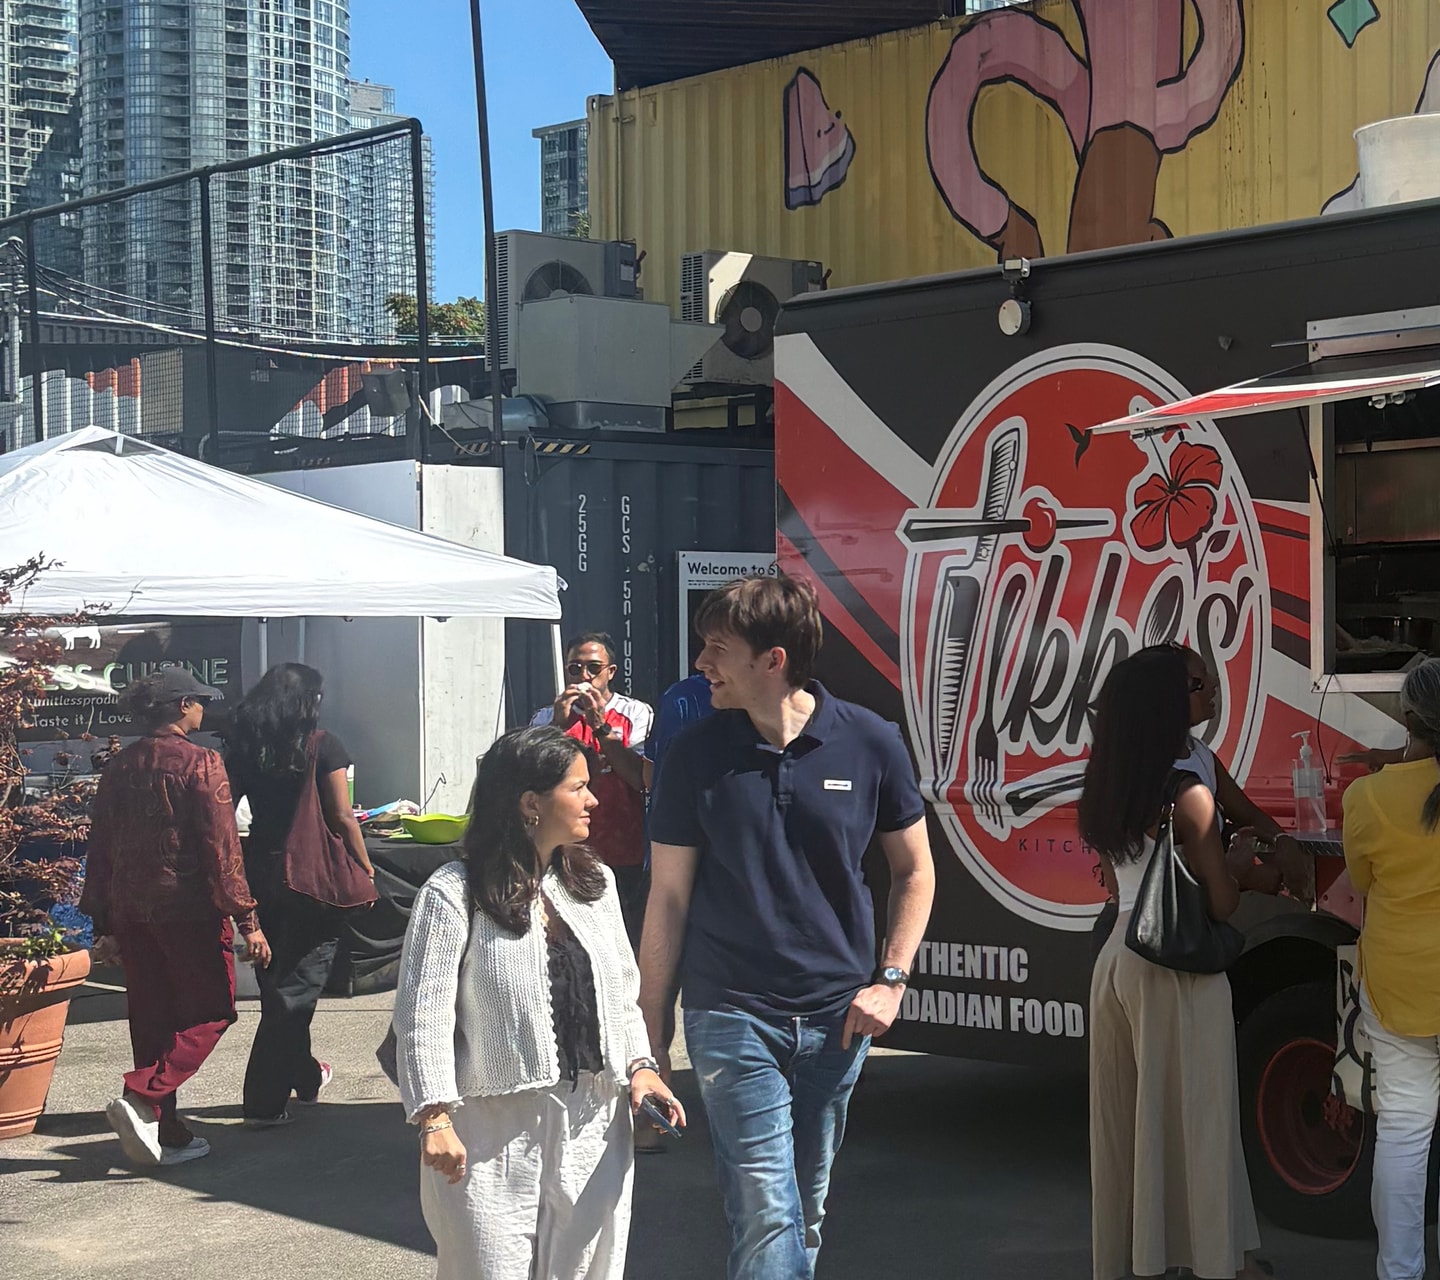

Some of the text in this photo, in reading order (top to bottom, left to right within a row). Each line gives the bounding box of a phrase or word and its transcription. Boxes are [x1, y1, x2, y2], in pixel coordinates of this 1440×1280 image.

[687, 562, 747, 575] Welcome
[752, 565, 765, 575] to
[32, 715, 69, 728] Taste
[99, 710, 132, 724] Love
[1018, 838, 1092, 855] KITCH
[882, 938, 1029, 984] THENTIC
[897, 987, 1085, 1038] DADIAN FOOD
